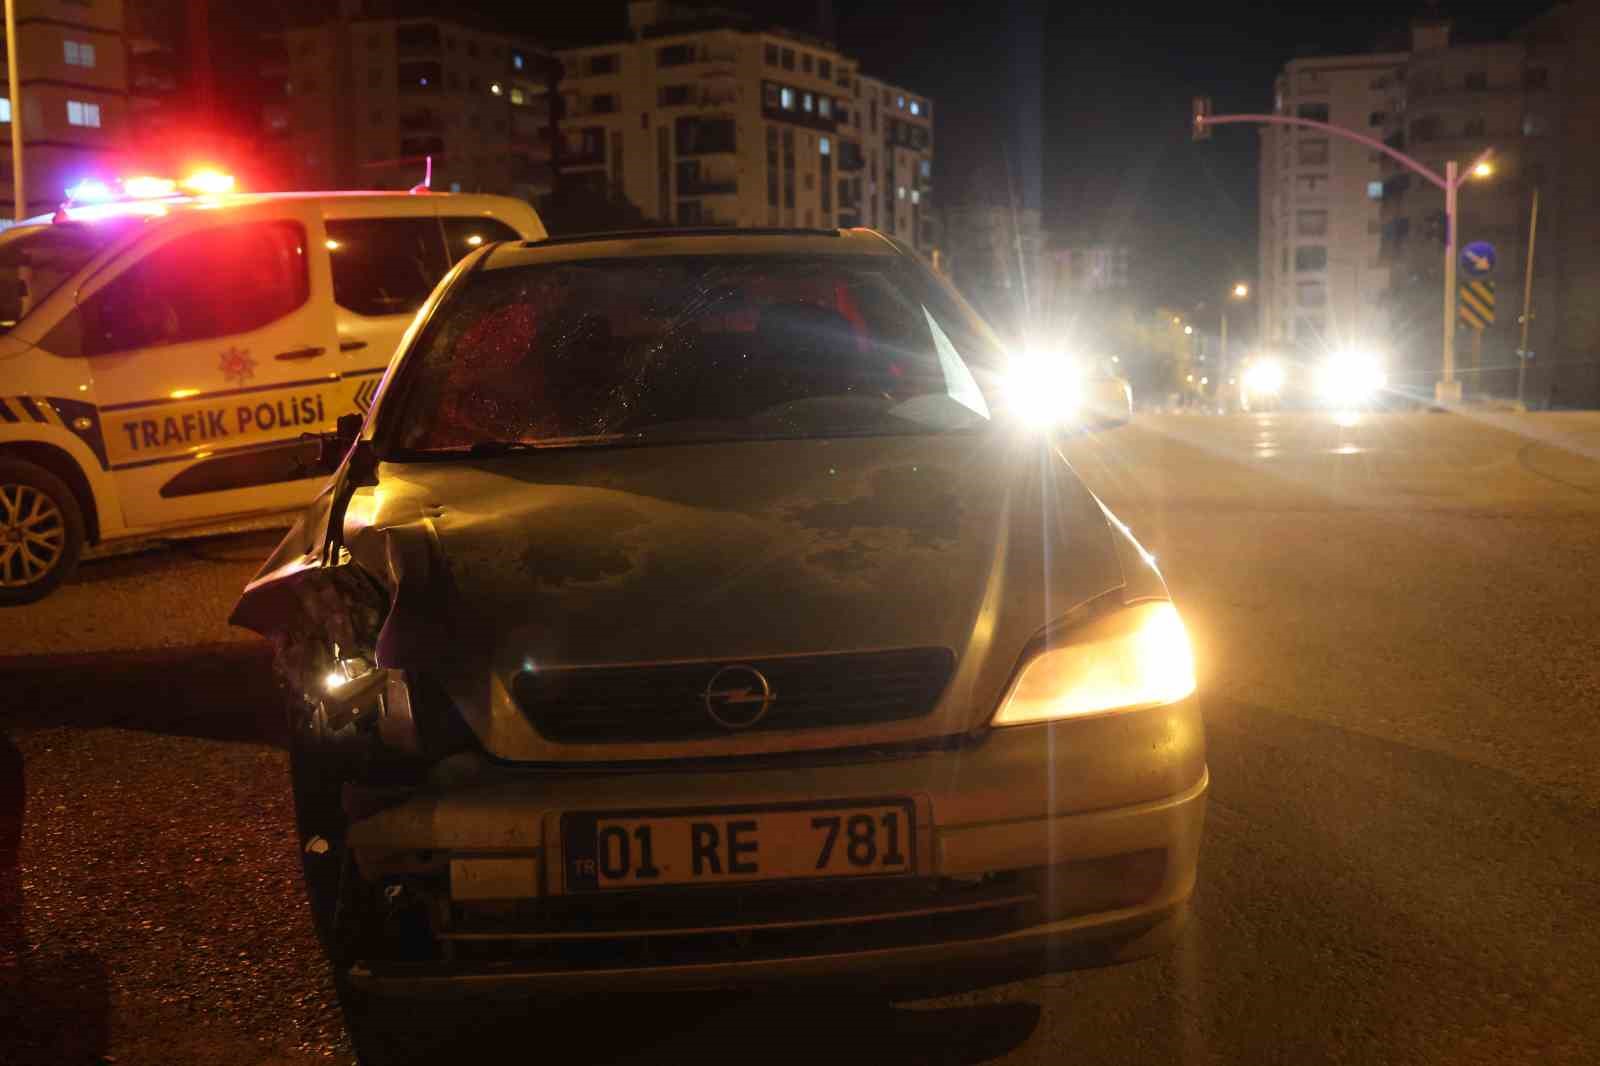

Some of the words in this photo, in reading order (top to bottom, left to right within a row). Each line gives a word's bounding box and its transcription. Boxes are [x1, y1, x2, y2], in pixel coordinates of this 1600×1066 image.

[599, 825, 659, 879] 01
[691, 820, 759, 875] RE
[811, 812, 905, 869] 781
[575, 860, 594, 879] TR
